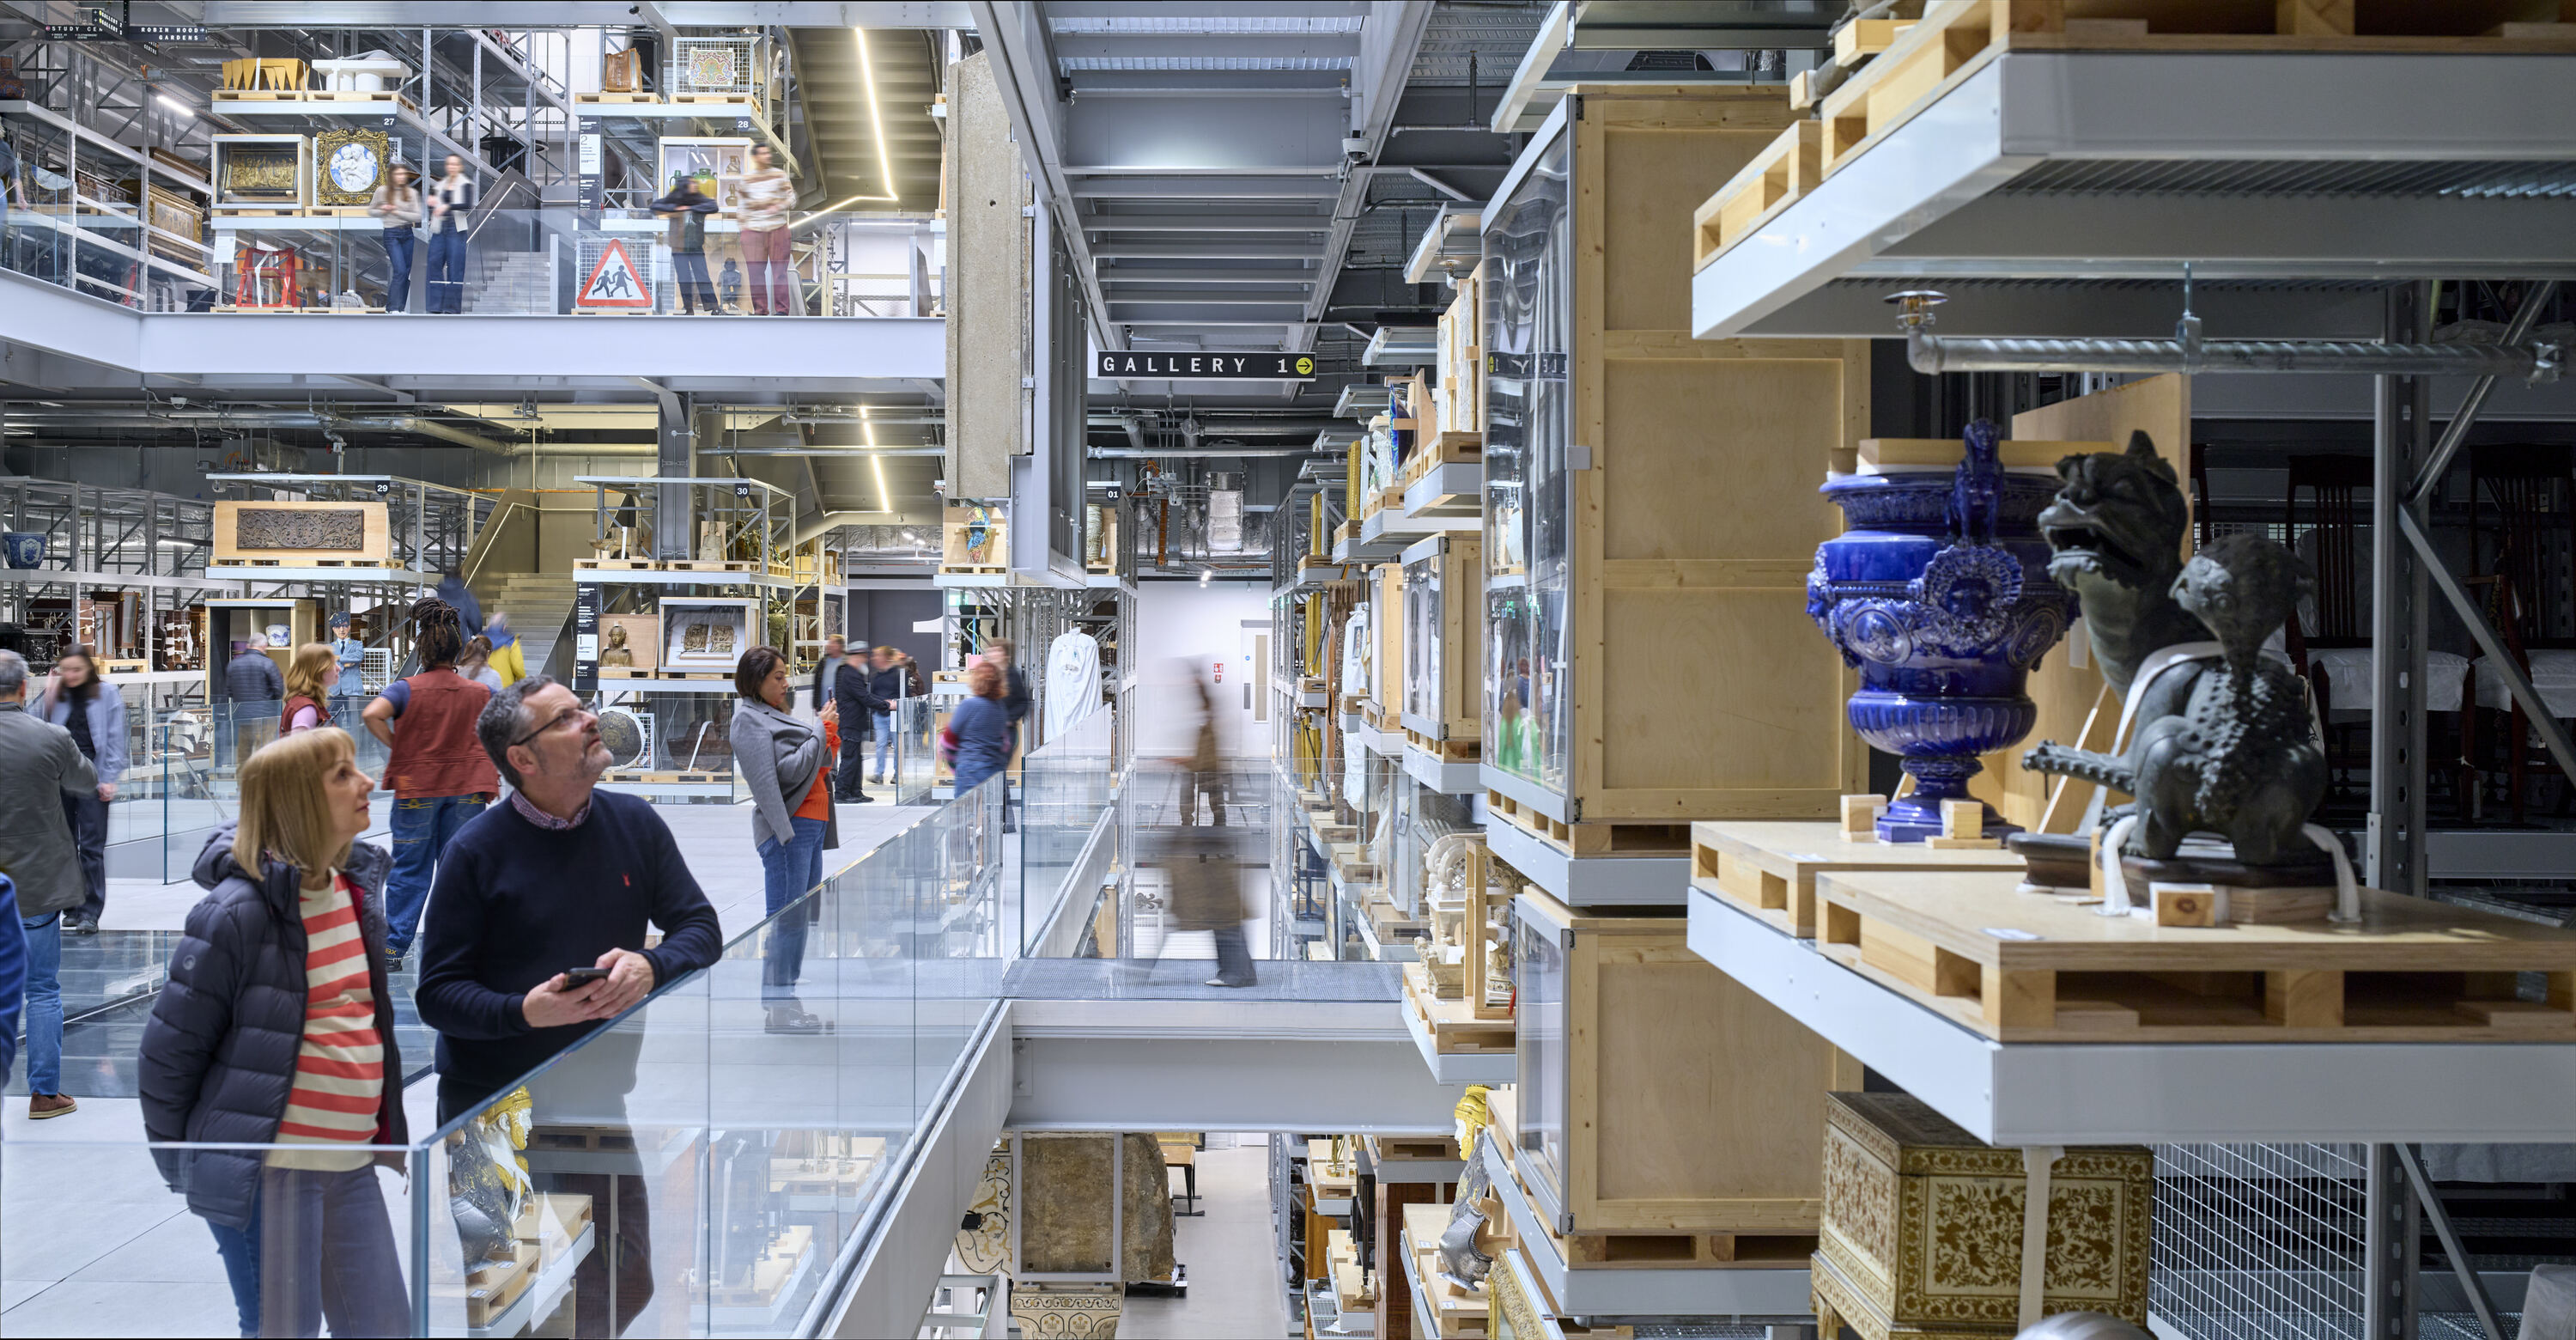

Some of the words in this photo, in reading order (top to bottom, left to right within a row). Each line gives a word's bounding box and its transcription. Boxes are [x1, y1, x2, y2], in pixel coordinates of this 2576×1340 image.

[101, 11, 118, 25] GALLERY
[581, 135, 587, 145] 2
[1103, 356, 1246, 373] GALLERY
[1277, 357, 1288, 374] 1
